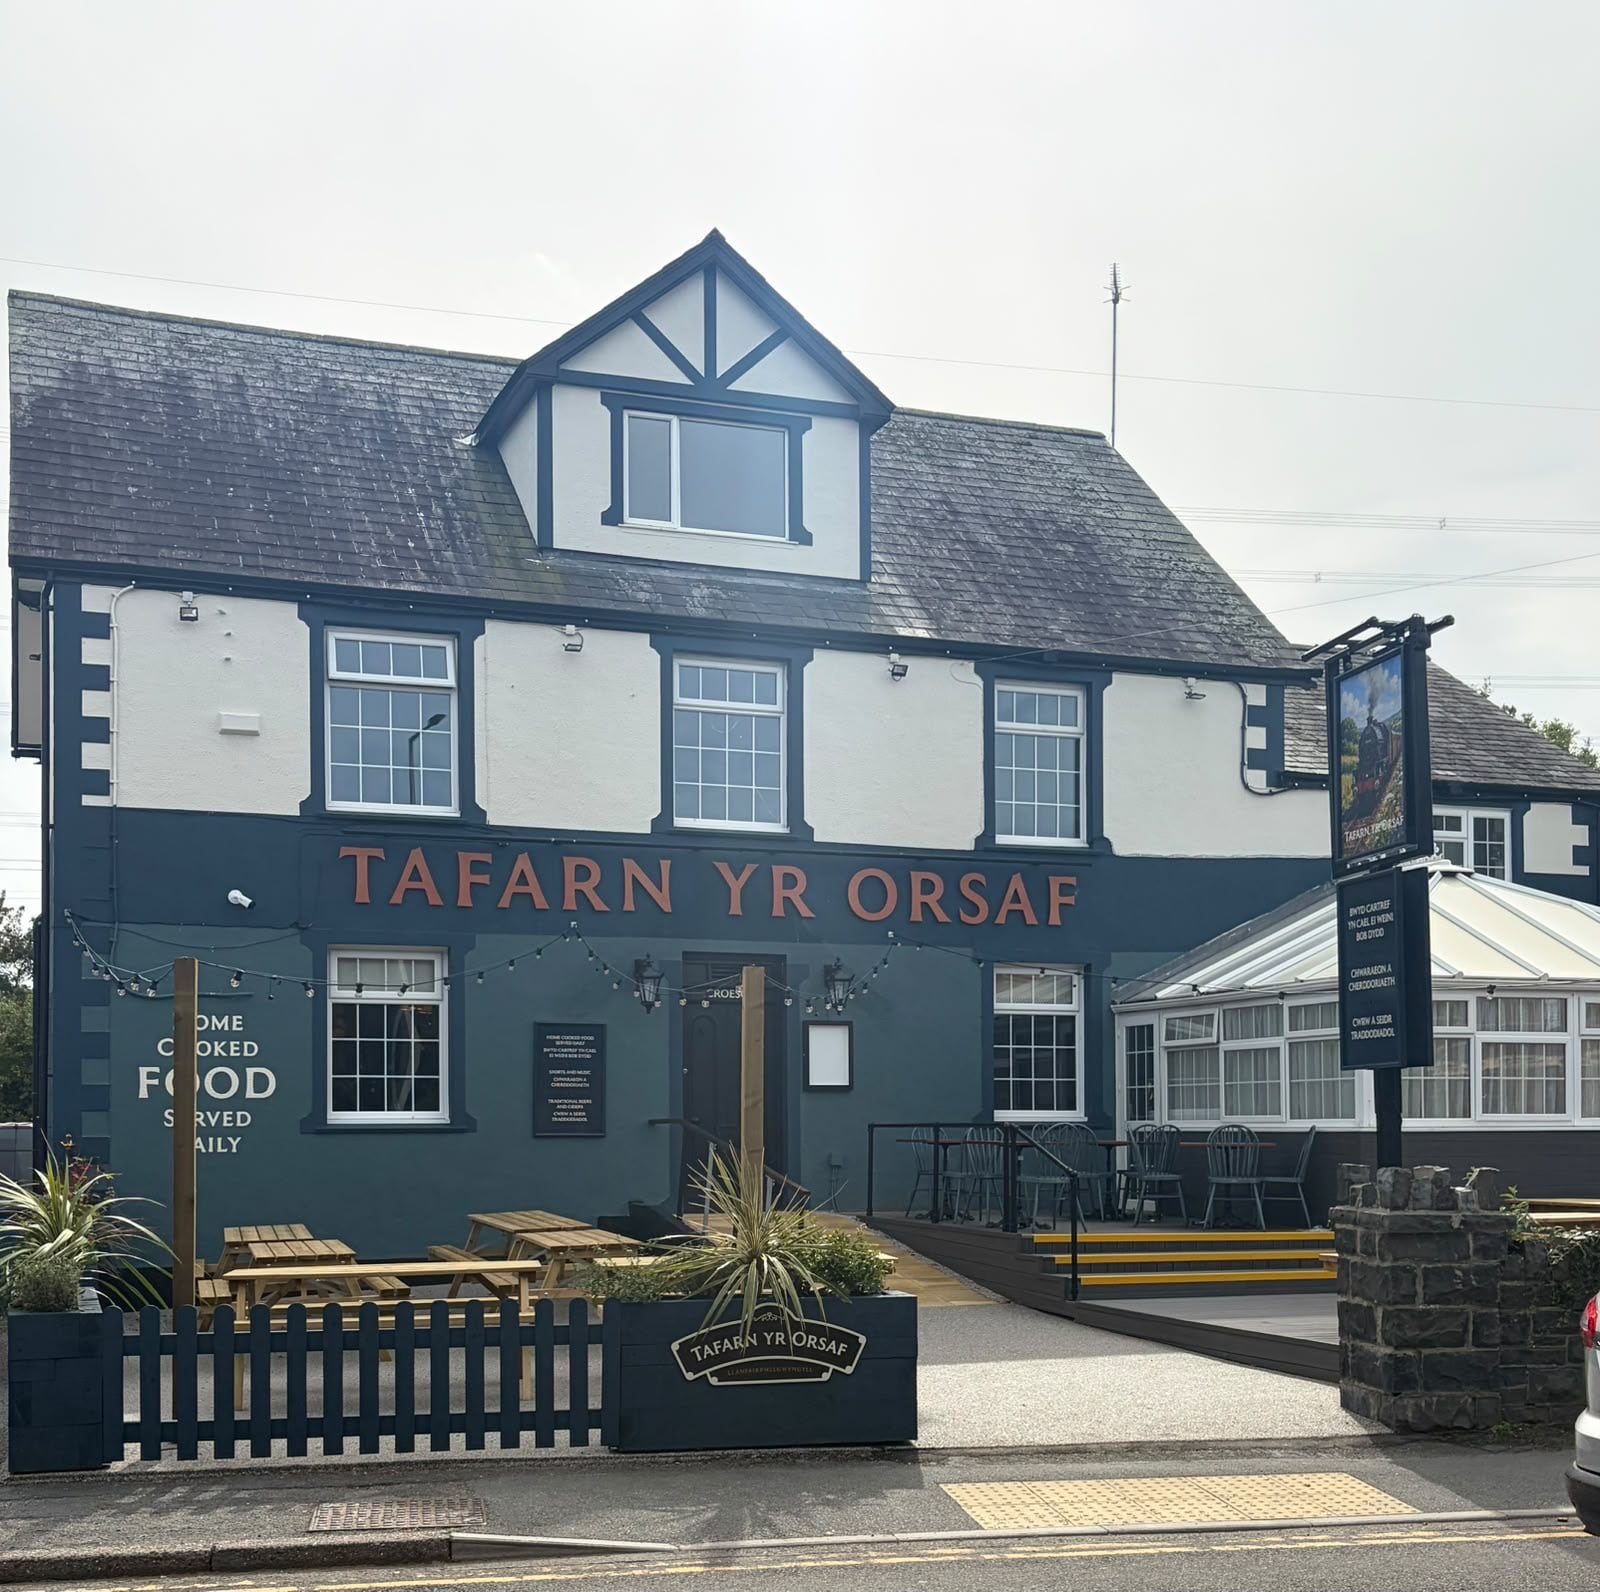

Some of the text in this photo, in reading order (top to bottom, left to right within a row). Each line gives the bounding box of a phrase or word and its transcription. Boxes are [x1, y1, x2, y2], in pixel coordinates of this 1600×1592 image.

[1344, 826, 1370, 842] TAFARN
[1381, 816, 1404, 831] ORSAF
[338, 846, 1078, 927] TAFARN YR ORSAF
[1349, 899, 1391, 917] BWYD CARTREF
[1356, 917, 1370, 928] CAEL
[1356, 928, 1384, 941] BOB DYDD
[1350, 963, 1392, 978] CHWARAEON A
[706, 988, 742, 998] CROES
[173, 1013, 244, 1031] OME
[1371, 1015, 1376, 1025] A
[157, 1038, 259, 1057] COKED
[163, 1109, 252, 1127] SRVED
[194, 1136, 242, 1153] AILY
[690, 1331, 848, 1361] TAFARN YR ORSAF
